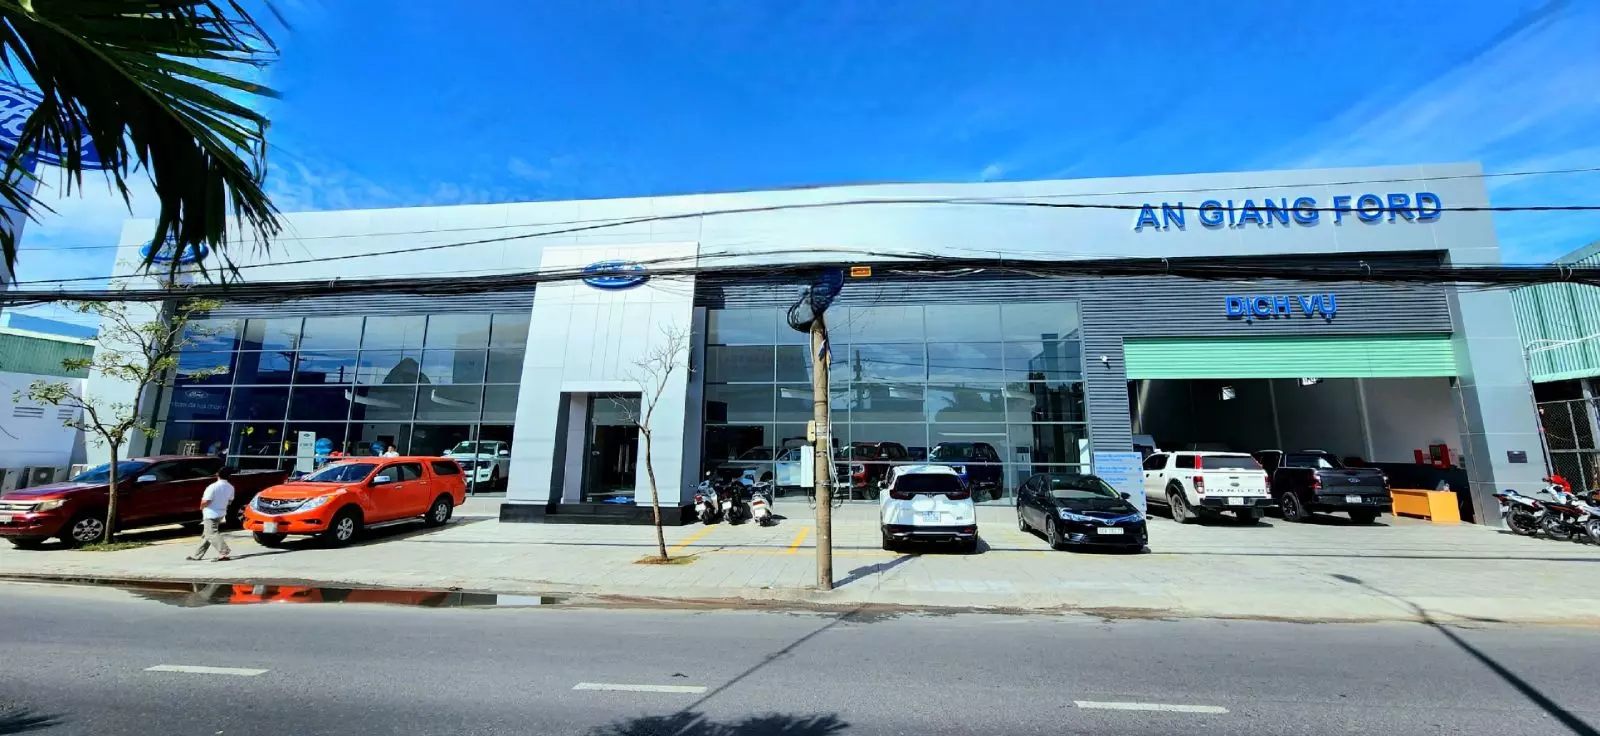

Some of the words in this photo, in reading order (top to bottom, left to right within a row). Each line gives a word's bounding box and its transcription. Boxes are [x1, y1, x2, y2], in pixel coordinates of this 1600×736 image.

[1135, 202, 1185, 228] AN
[1199, 197, 1319, 226] GIANG
[1333, 192, 1441, 223] FORD
[1225, 295, 1291, 321] DỊCH
[1297, 294, 1337, 319] VỤ
